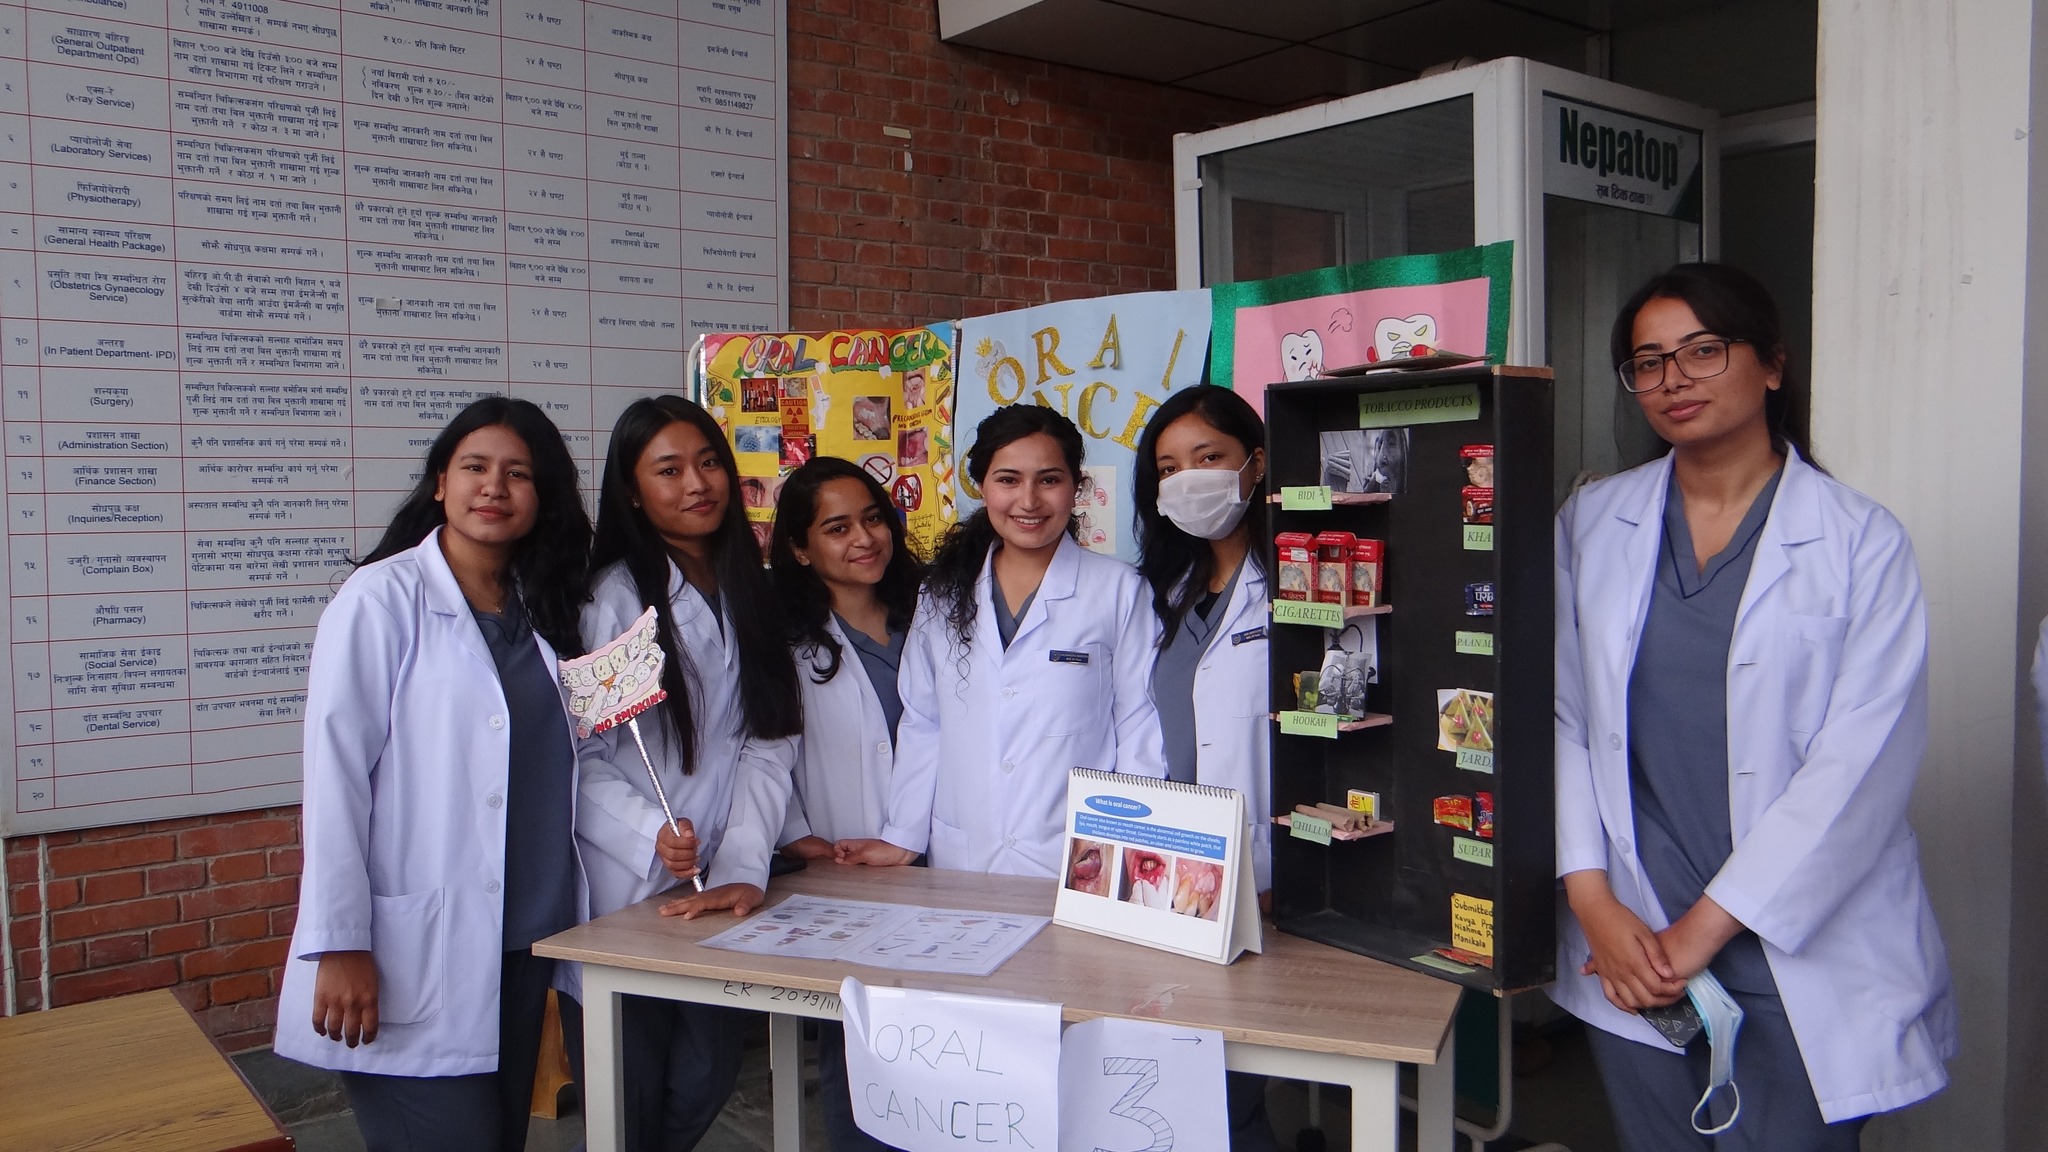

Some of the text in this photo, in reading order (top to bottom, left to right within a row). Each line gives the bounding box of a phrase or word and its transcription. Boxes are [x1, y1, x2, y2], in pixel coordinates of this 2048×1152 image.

[51, 36, 144, 54] (General Outpatient
[57, 45, 139, 64] Department Opd)
[95, 96, 134, 109] Service)
[50, 143, 151, 162] (Laboratory Services)
[1560, 106, 1678, 191] Nepatop
[67, 192, 141, 207] (Physiotherapy)
[43, 235, 165, 252] (General Health Package)
[89, 292, 128, 302] Service)
[104, 283, 164, 296] Gynaecology
[44, 346, 56, 355] (In
[59, 346, 93, 355] Patient
[155, 350, 178, 361] IPD)
[742, 331, 931, 374] ORAL CANCER
[89, 396, 133, 407] (Surgery)
[1364, 395, 1473, 414] TOBACCO PRODUCTS
[58, 441, 168, 450] (Administration Section)
[74, 476, 156, 486] (Finance Section)
[1298, 490, 1315, 501] BIDI
[82, 564, 153, 575] (Complain Box)
[92, 615, 146, 625] (Pharmacy)
[1274, 605, 1341, 623] CIGARETTES
[1456, 637, 1493, 648] PAAN M
[84, 657, 157, 670] (Social Service)
[595, 689, 668, 734] NO SMOKING
[86, 719, 160, 732] (Dental Service)
[1292, 714, 1327, 728] HOOKAH
[1459, 751, 1492, 768] JARD
[1095, 798, 1108, 806] What
[1113, 800, 1122, 808] oral
[1123, 803, 1141, 811] cancer?
[1292, 819, 1331, 839] CHILLUM
[875, 1024, 1003, 1075] ORAL
[1093, 1057, 1174, 1152] 3
[865, 1083, 1034, 1149] CANCER
